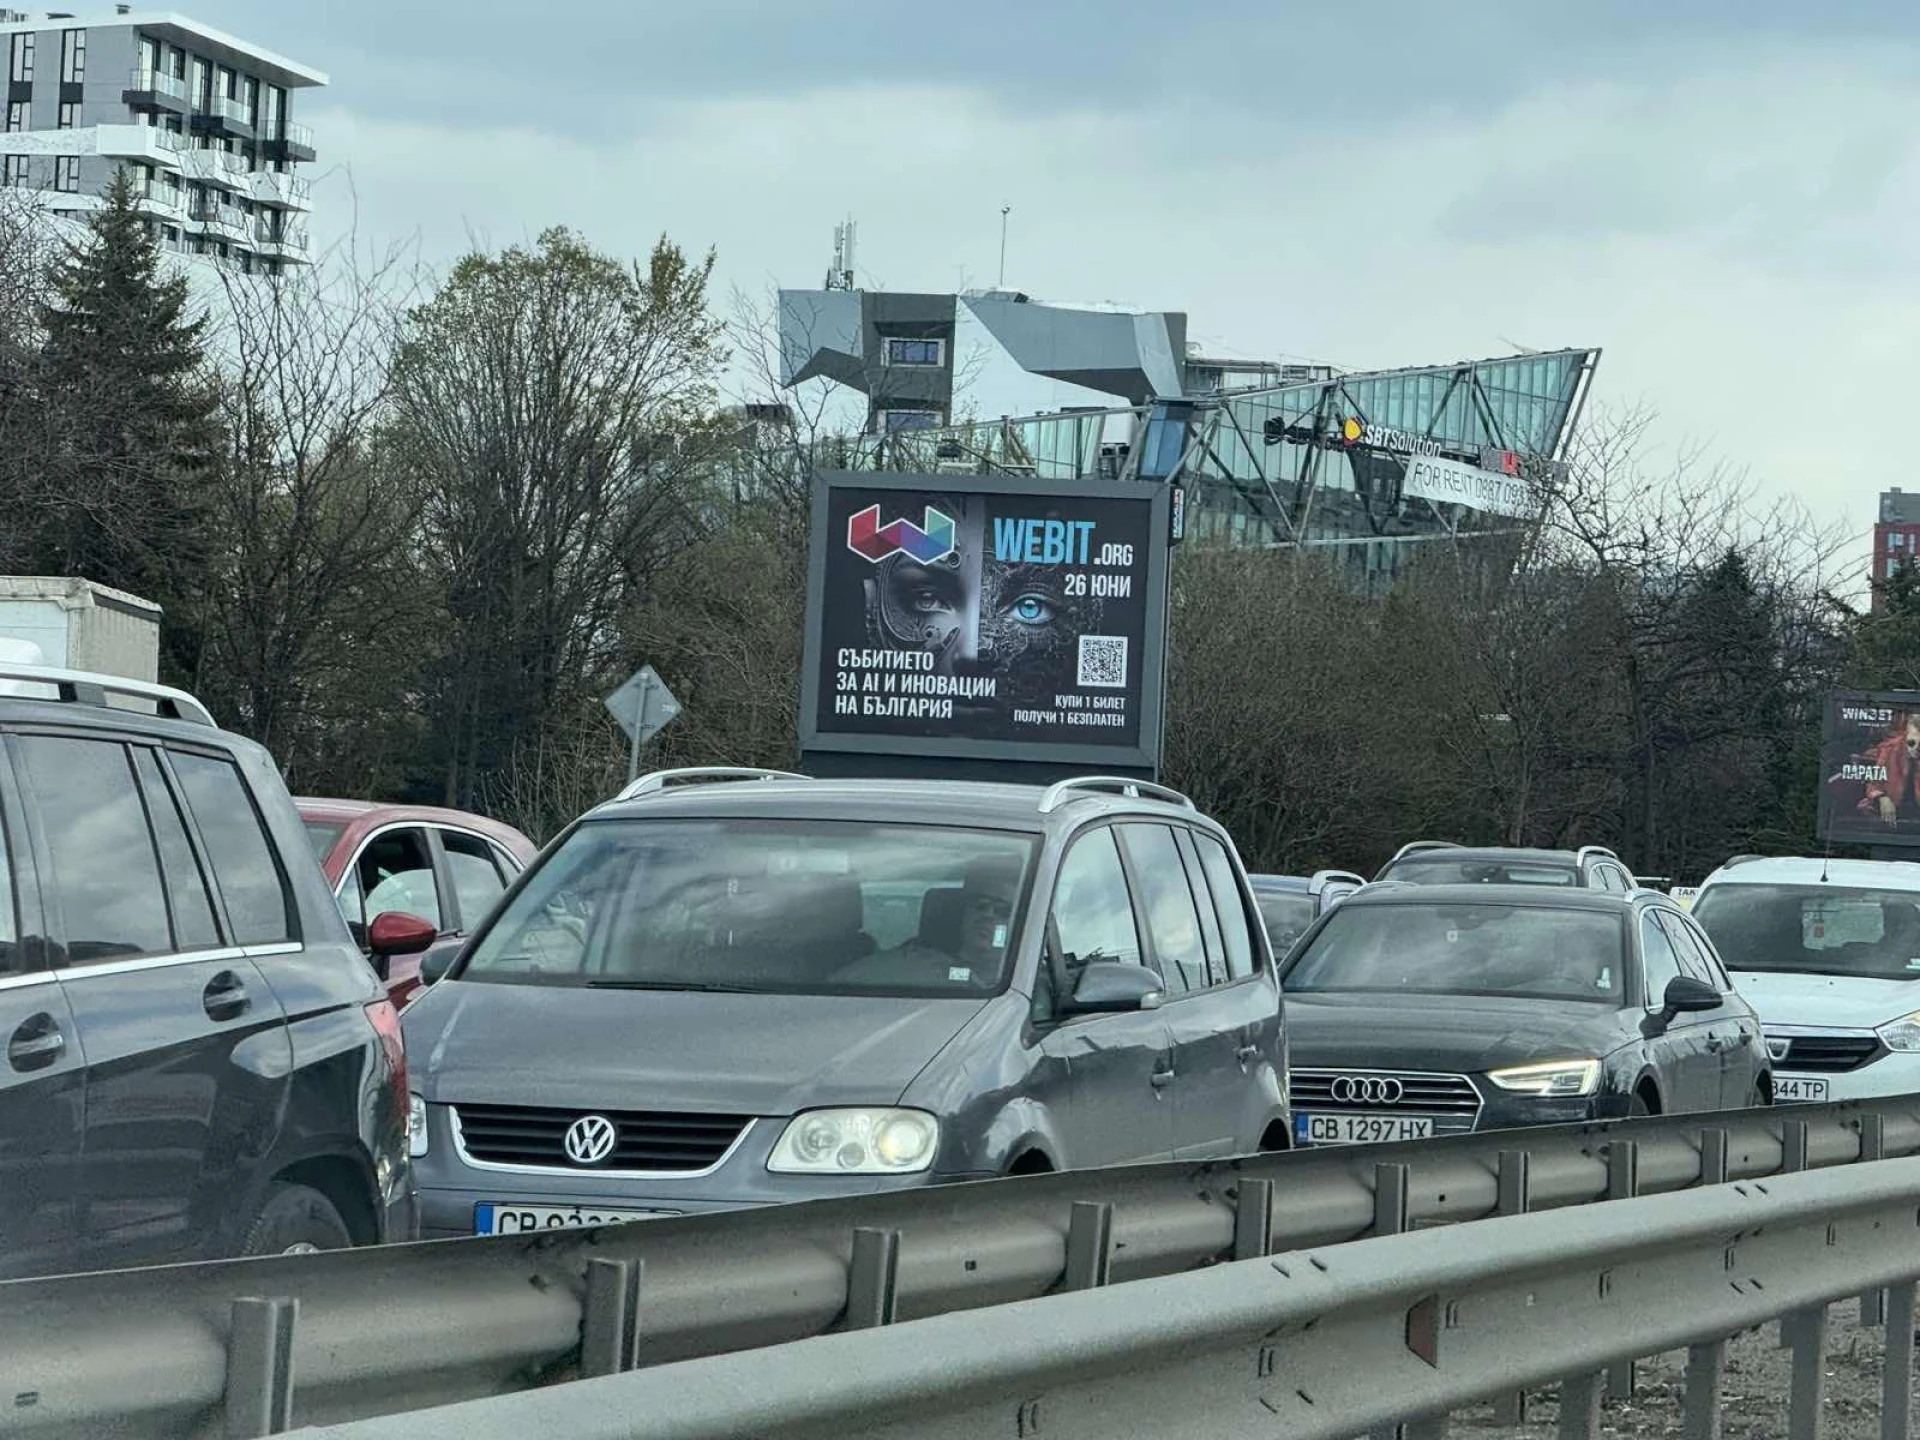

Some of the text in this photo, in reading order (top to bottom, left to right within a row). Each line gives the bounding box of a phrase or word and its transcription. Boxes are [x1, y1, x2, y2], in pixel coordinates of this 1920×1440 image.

[1414, 462, 1442, 487] FOR
[1443, 466, 1475, 495] RENT
[1064, 573, 1132, 598] 26 ЮНИ
[838, 647, 935, 671] СЪБИТИЕТО
[836, 671, 858, 691] ЗА
[884, 673, 896, 693] И
[900, 674, 997, 699] ИНОВАЦИИ
[835, 694, 953, 719] НА БЪЛГАРИЯ
[1055, 694, 1126, 710] КУПИ 1 БИЛЕТ
[1014, 709, 1125, 727] ПОЛУЧИ 1 БЕЗПЛАТЕН
[1802, 1081, 1825, 1098] TP
[1311, 1117, 1429, 1142] CB 1297 HX
